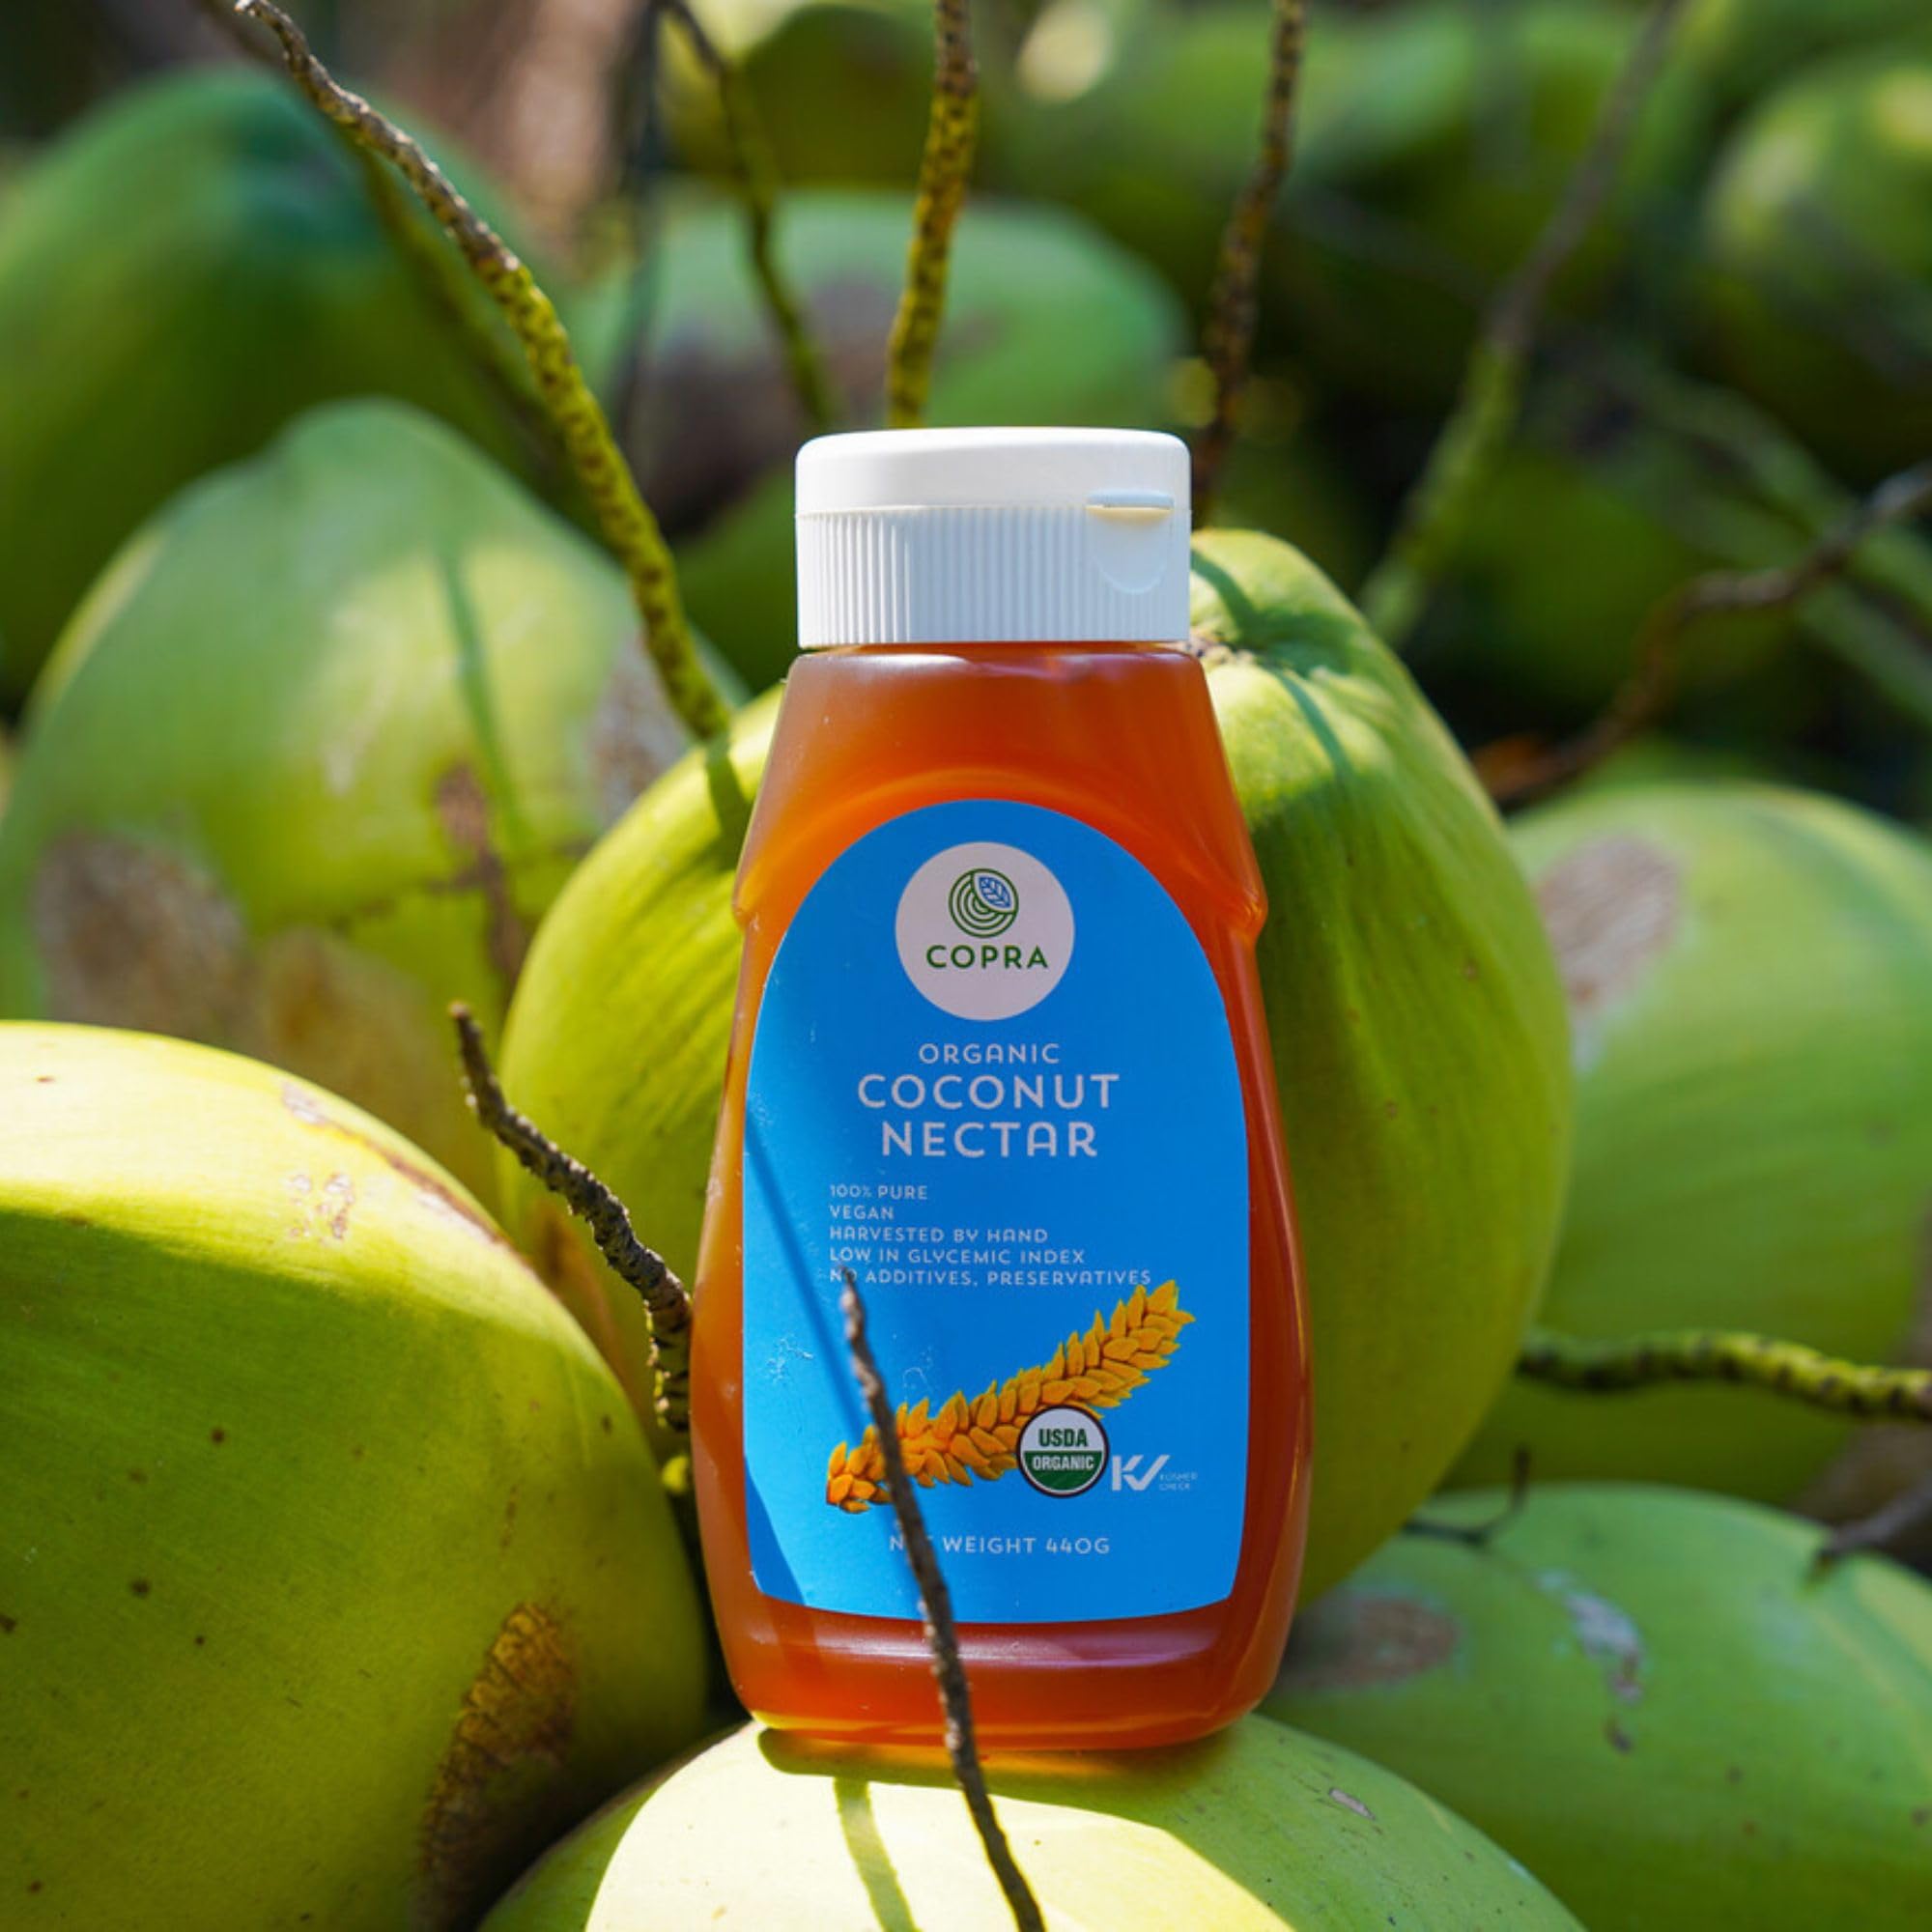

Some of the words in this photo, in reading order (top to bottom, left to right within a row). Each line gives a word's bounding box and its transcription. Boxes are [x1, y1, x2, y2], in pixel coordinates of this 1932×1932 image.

[926, 945, 1048, 969] COPRA
[919, 1043, 1060, 1064] ORGANIC
[858, 1073, 1120, 1110] COCONUT
[881, 1121, 1097, 1158] NECTAR
[830, 1184, 871, 1198] 100%
[878, 1185, 927, 1200] PURE
[830, 1205, 895, 1220] VEGAN
[830, 1227, 945, 1242] HARVESTED
[953, 1229, 979, 1243] BY
[987, 1229, 1048, 1243] HAND
[830, 1246, 871, 1262] LOW
[880, 1247, 899, 1263] IN
[908, 1249, 1010, 1264] GLYCEMIC
[1021, 1249, 1085, 1264] INDEX
[866, 1269, 979, 1287] ADDITIVES,
[987, 1269, 1151, 1286] PRESERVATIVES
[1038, 1428, 1089, 1447] USDA
[1032, 1455, 1094, 1471] ORGANIC
[943, 1536, 1037, 1554] WEIGHT
